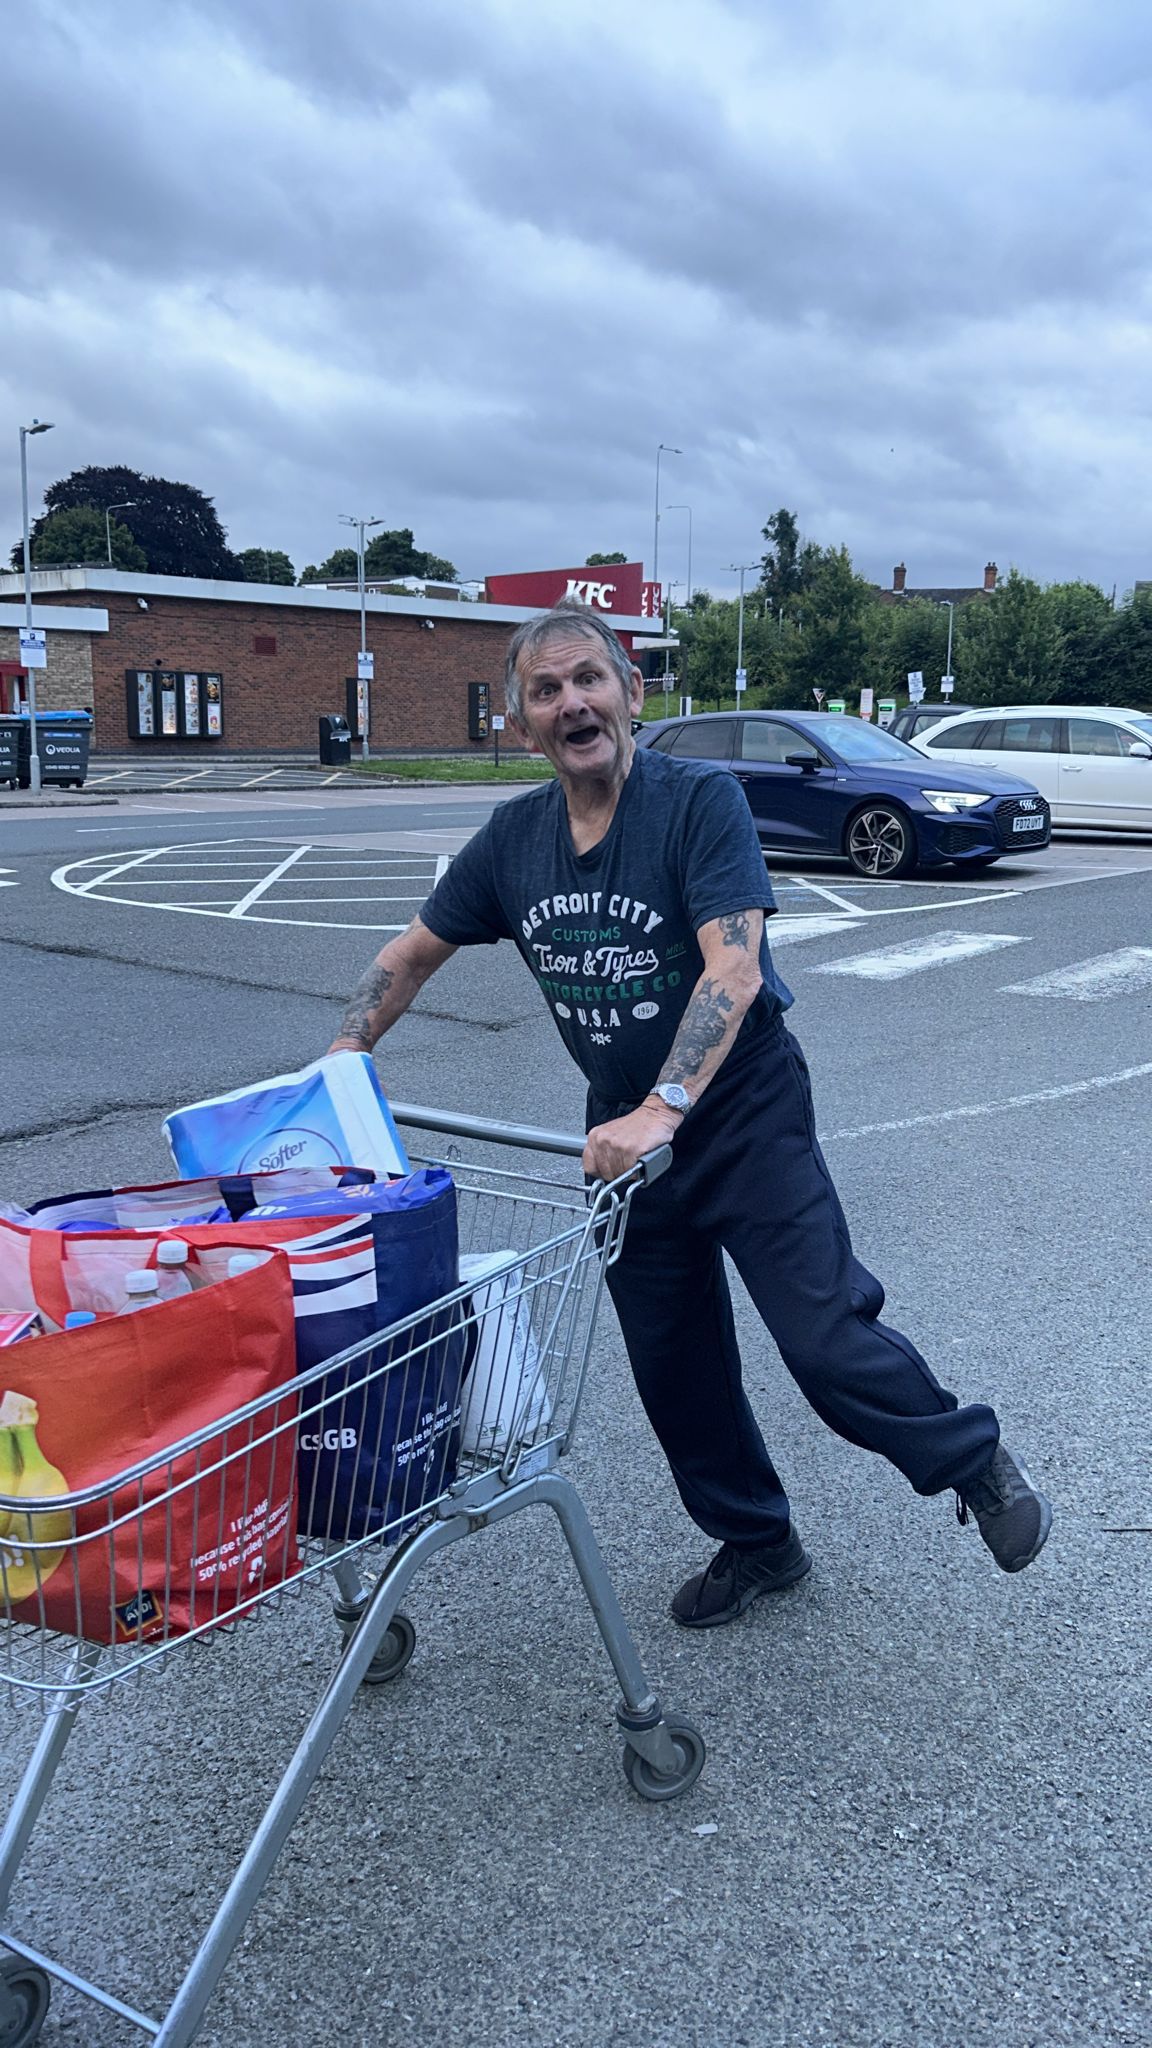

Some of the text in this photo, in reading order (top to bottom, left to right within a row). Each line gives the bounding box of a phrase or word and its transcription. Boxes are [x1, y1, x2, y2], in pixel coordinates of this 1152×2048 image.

[566, 579, 614, 609] KFC
[652, 585, 660, 618] KFC
[56, 746, 81, 754] VEOLIA
[522, 891, 664, 940] DETROIT CITY
[551, 926, 621, 942] CUSTOMS
[581, 950, 597, 976] &
[595, 944, 659, 984] Tyres
[652, 970, 681, 992] CO
[258, 1140, 308, 1172] Softer
[297, 1427, 358, 1451] csGB
[126, 1600, 153, 1622] ALDI
